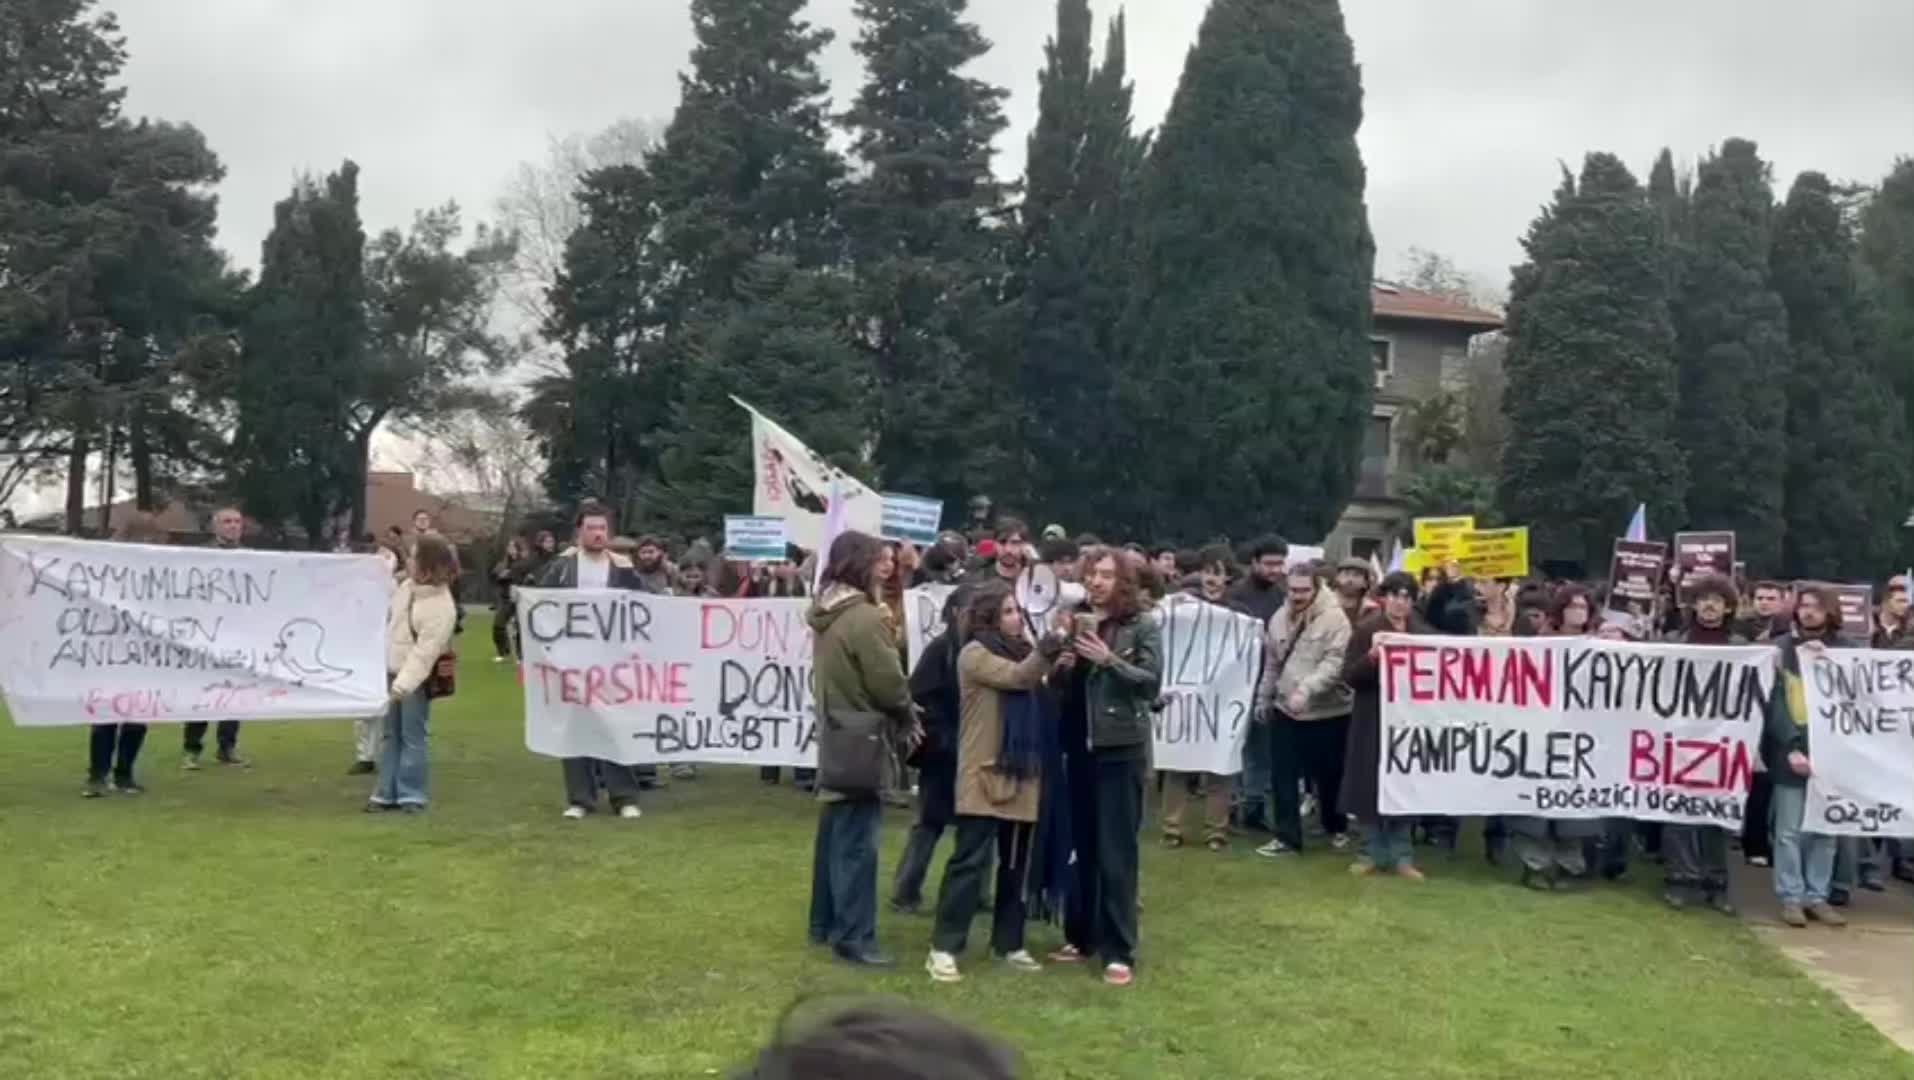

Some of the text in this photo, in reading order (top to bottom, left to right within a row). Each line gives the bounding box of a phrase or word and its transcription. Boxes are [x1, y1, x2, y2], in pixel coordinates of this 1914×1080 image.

[528, 595, 652, 651] ÇEVİR
[532, 653, 694, 706] TERSİNE
[1384, 645, 1552, 706] FERMAN
[1386, 722, 1596, 779] KAMPÜSLER
